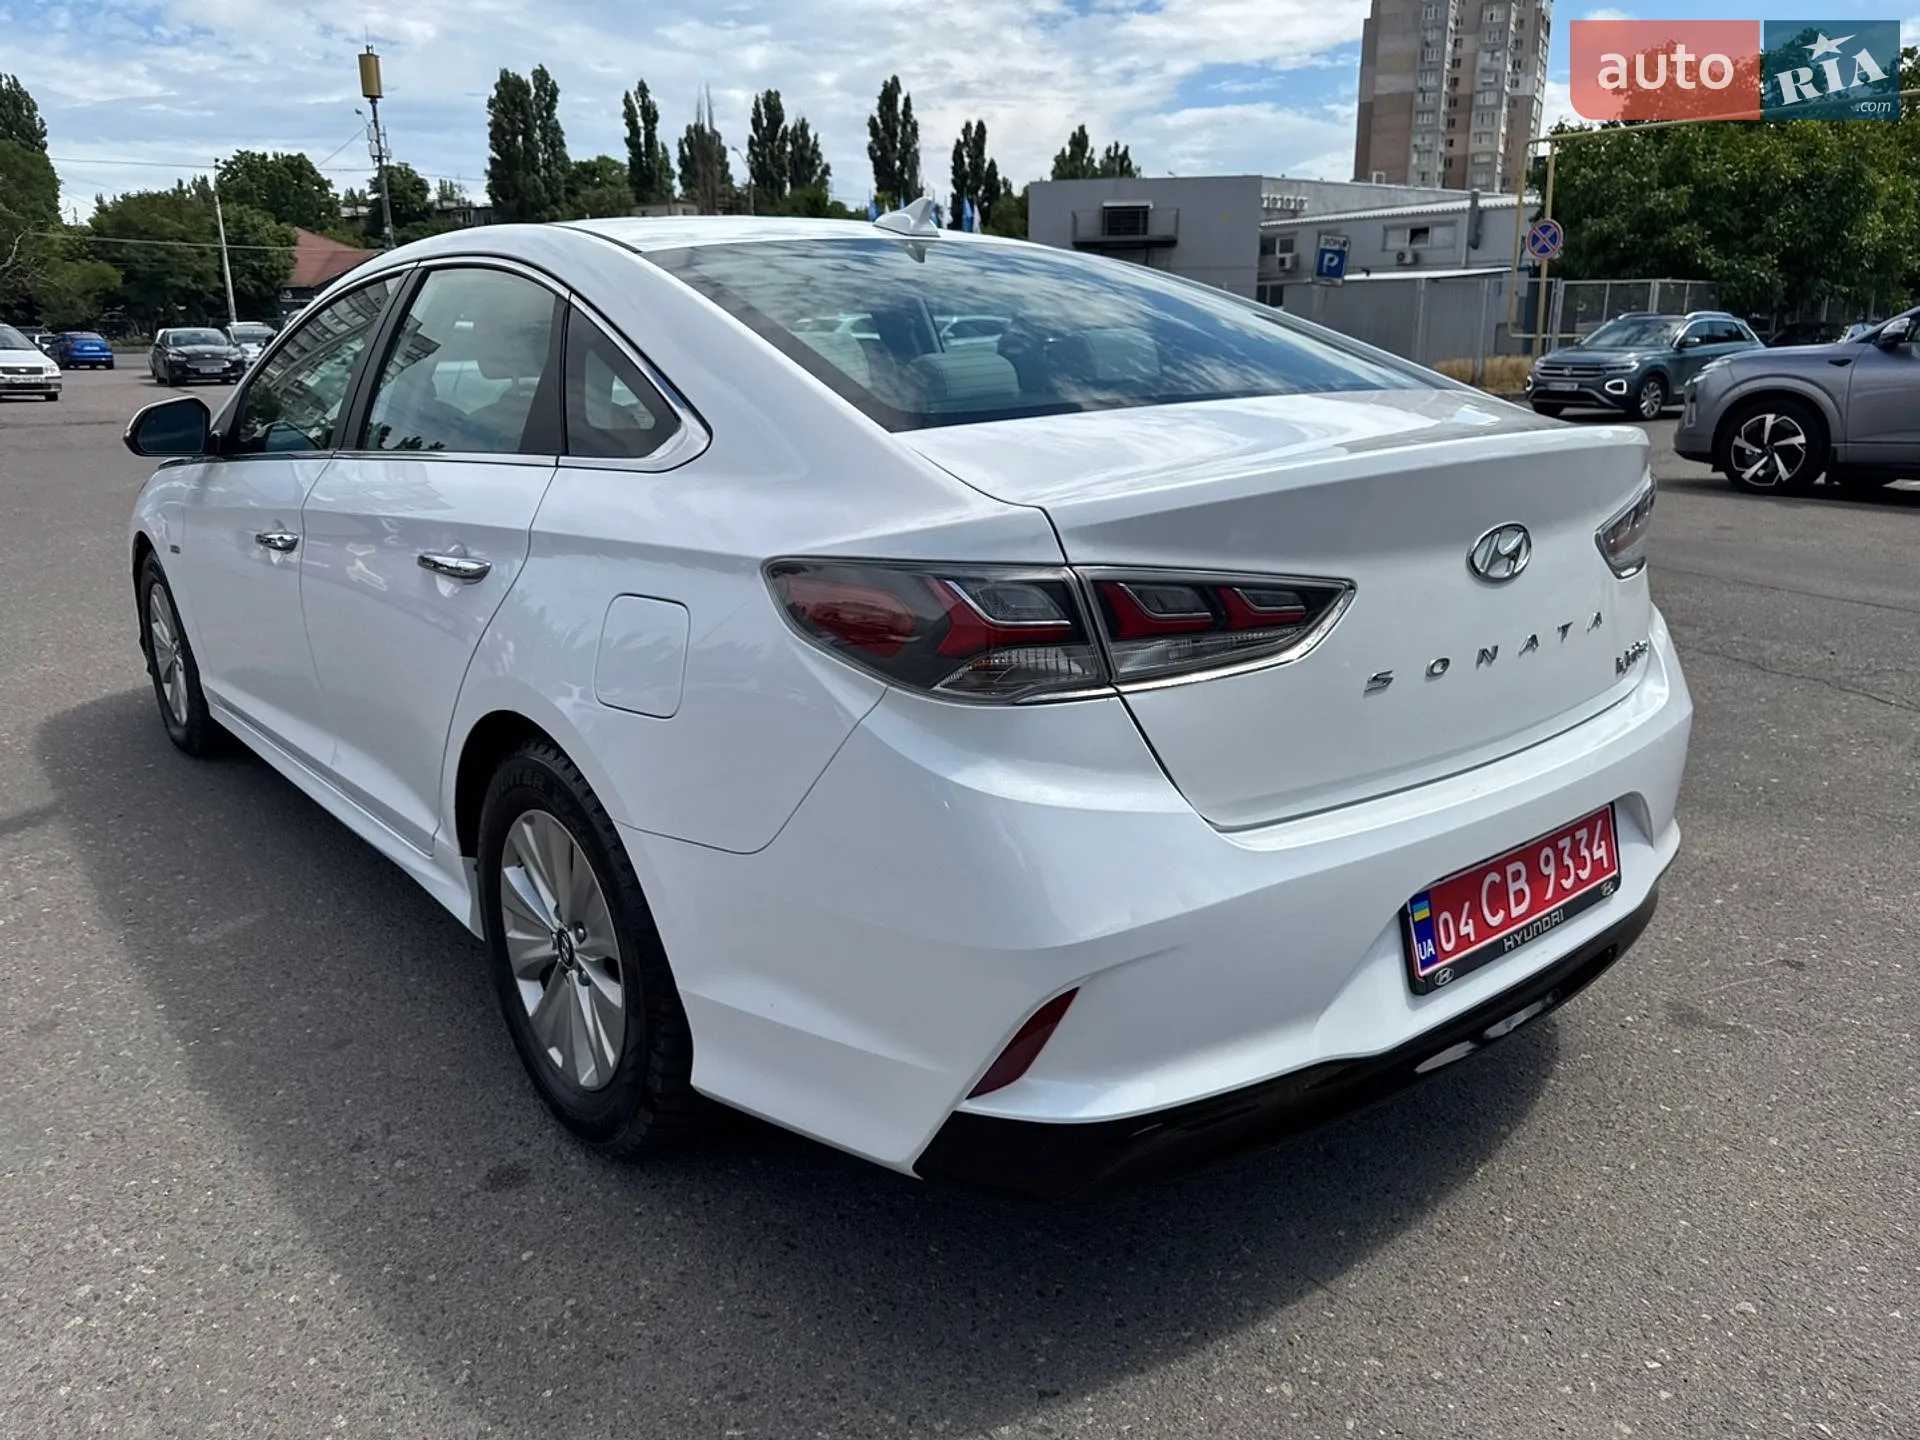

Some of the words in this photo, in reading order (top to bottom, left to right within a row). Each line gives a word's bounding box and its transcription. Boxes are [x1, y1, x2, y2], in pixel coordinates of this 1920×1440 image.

[1363, 611, 1602, 696] SONATA
[1437, 900, 1476, 952] 04
[1480, 860, 1532, 928] CB
[1538, 819, 1609, 901] 9334
[1418, 939, 1436, 960] UA
[1502, 909, 1565, 952] HYUNDAI
